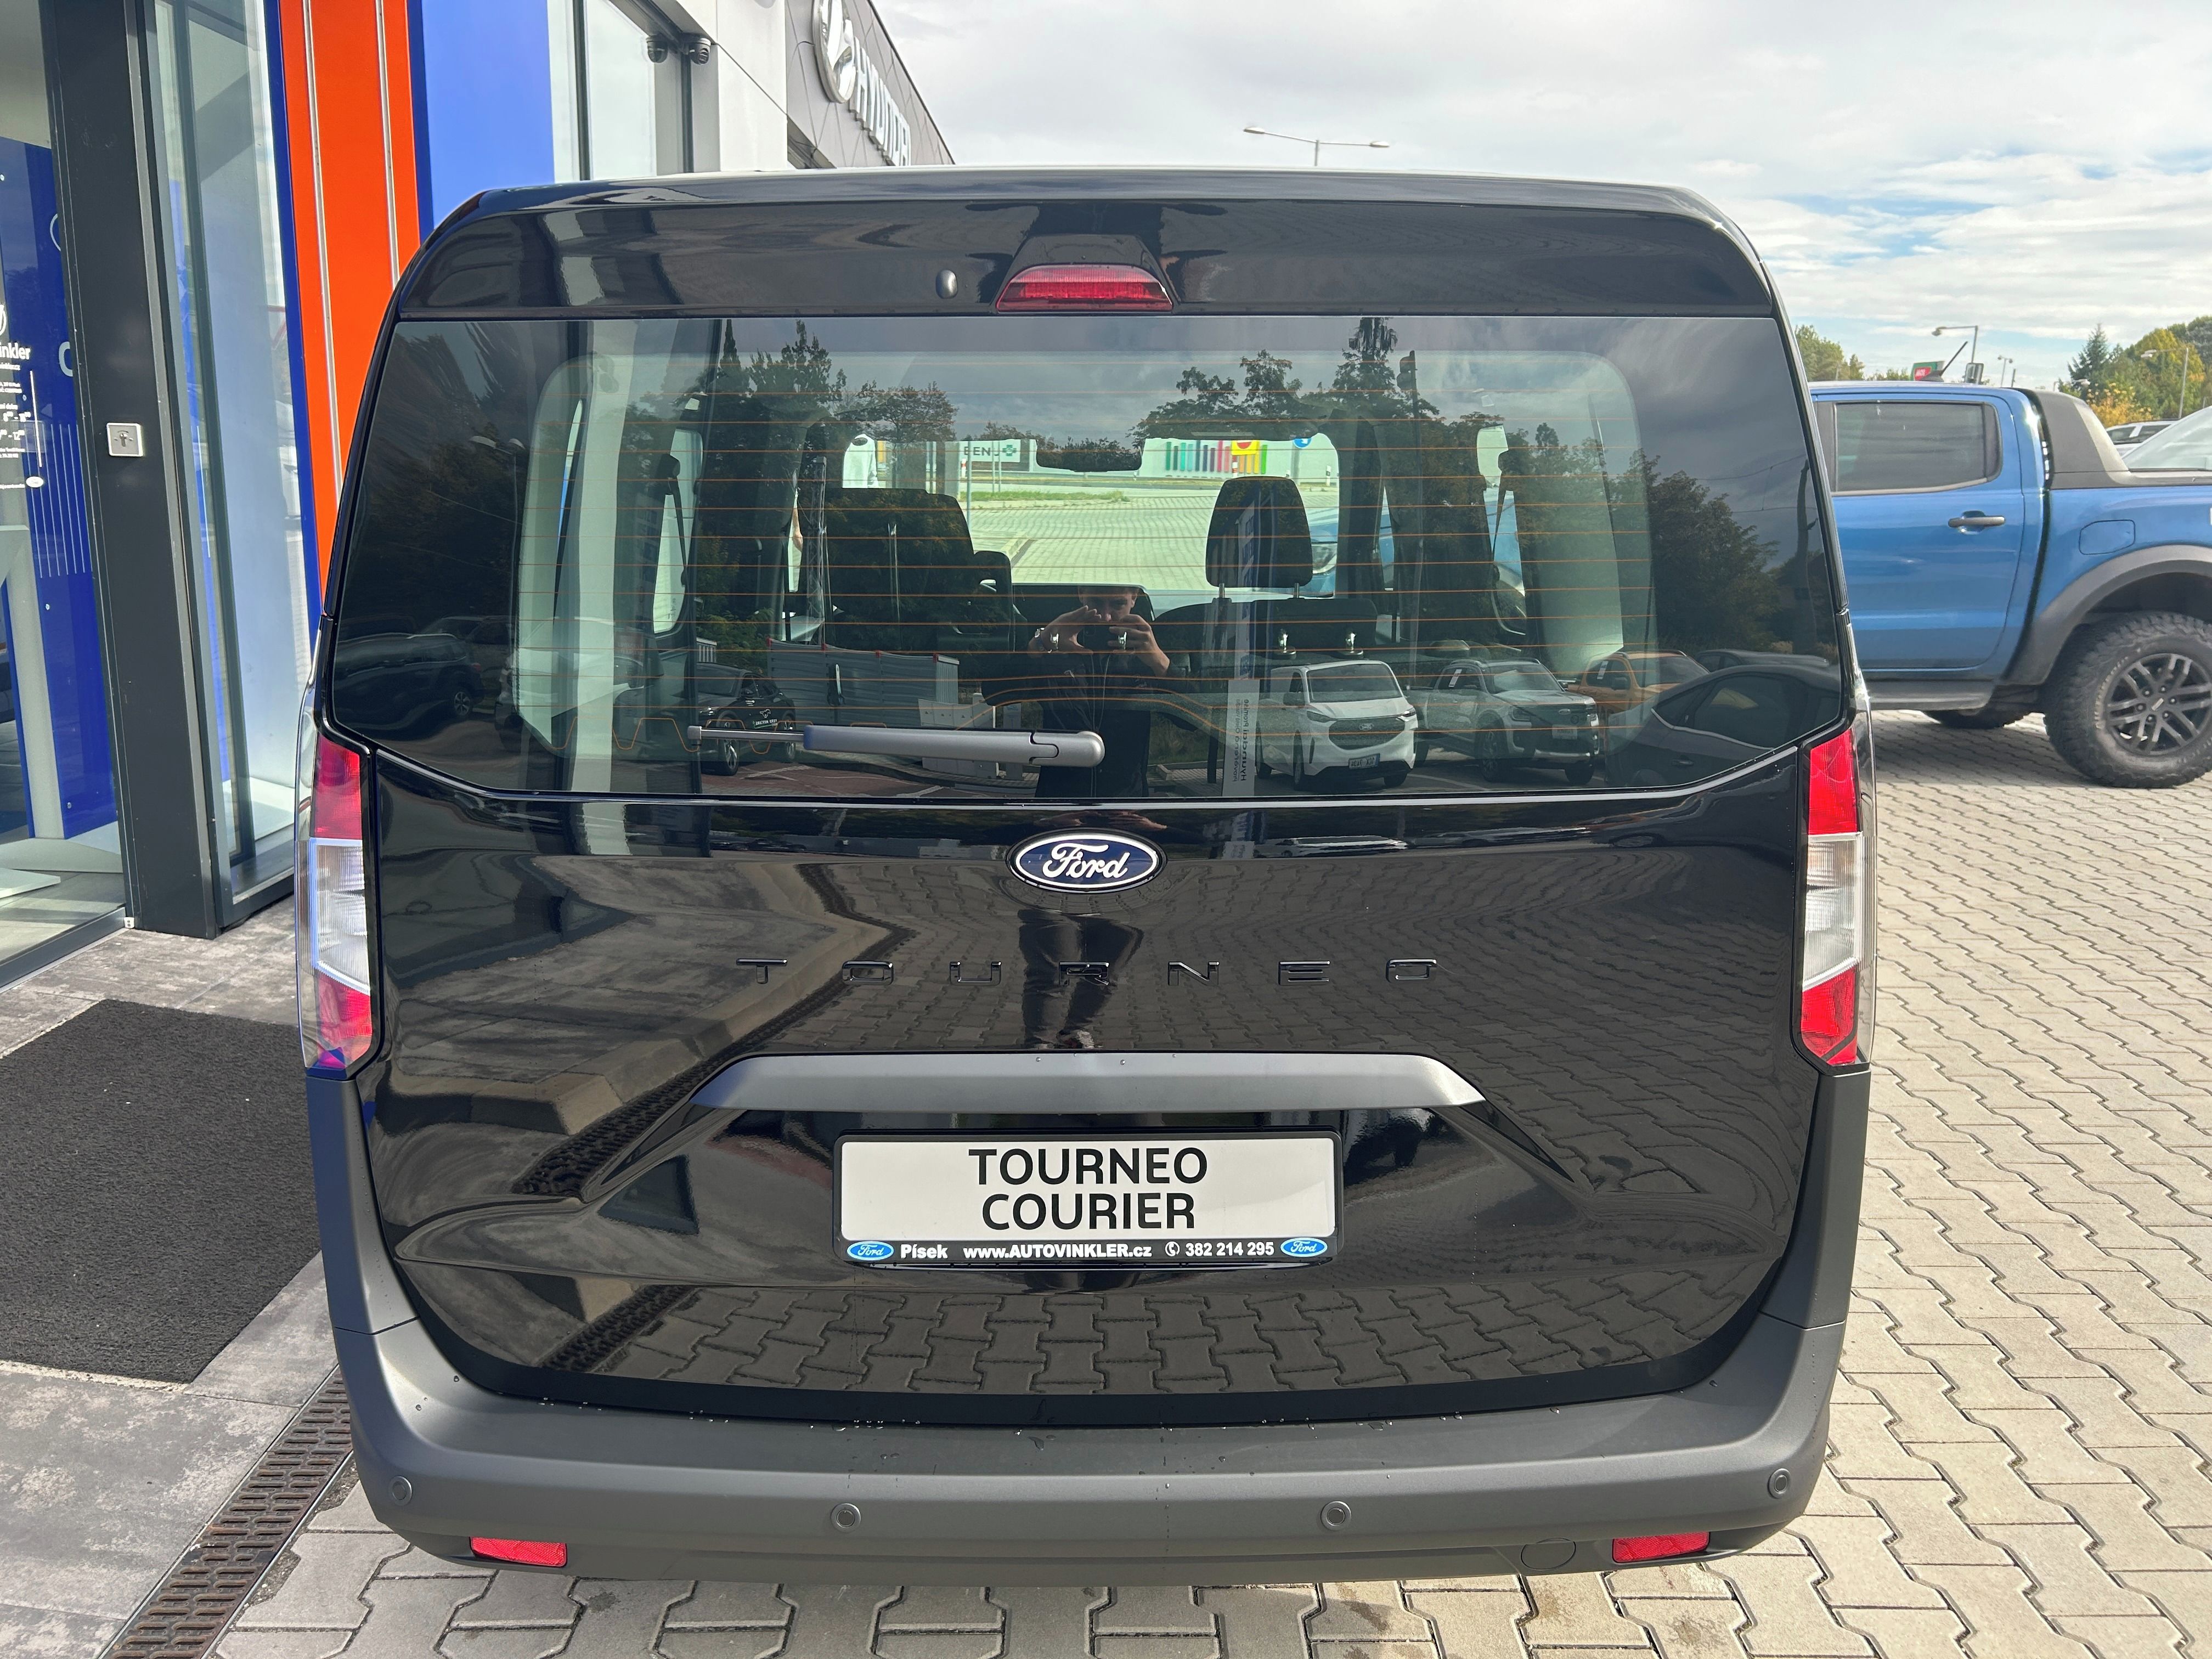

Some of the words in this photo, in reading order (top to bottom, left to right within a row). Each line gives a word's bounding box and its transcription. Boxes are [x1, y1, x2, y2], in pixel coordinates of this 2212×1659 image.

[1042, 843, 1130, 878] Ford
[736, 957, 1437, 986] TOURNEO
[968, 1147, 1207, 1185] TOURNEO
[982, 1193, 1194, 1230] COURIER
[857, 1243, 884, 1256] Ford
[900, 1244, 949, 1259] Písek
[963, 1244, 1153, 1259] www.AUTOVINKLER.cz
[1184, 1242, 1213, 1256] 382
[1216, 1242, 1244, 1256] 214
[1247, 1241, 1275, 1256] 295
[1290, 1240, 1317, 1252] Ford
